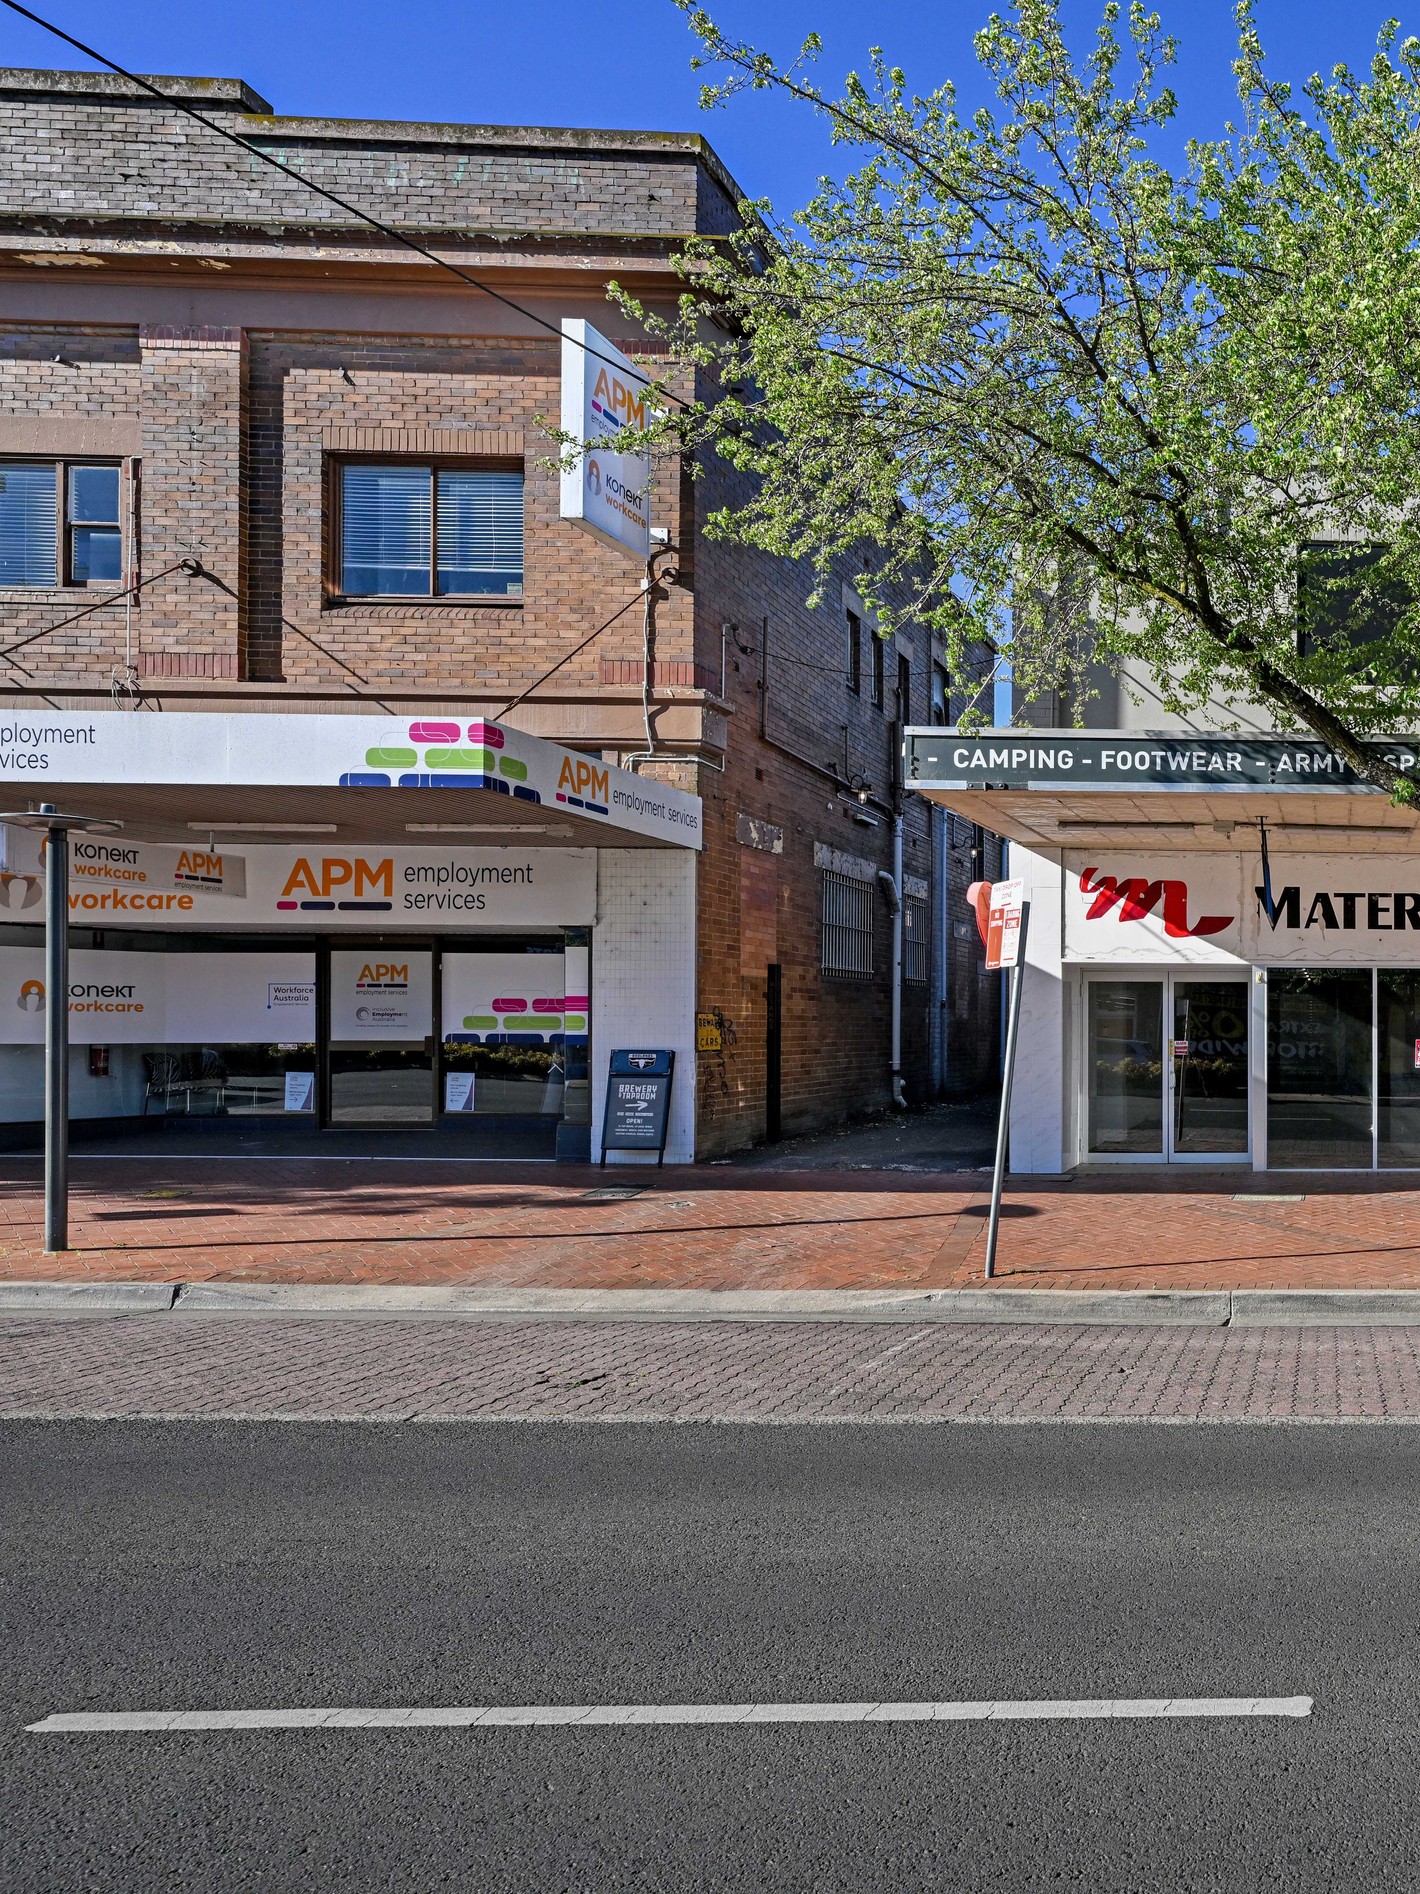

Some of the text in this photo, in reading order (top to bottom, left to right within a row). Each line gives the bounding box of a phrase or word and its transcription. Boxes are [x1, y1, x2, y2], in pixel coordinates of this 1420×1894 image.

[593, 367, 645, 431] APM
[605, 493, 647, 529] workcare
[953, 748, 1074, 770] CAMPING
[1100, 750, 1243, 772] FOOTWEAR
[1276, 753, 1347, 773] ARMY
[558, 755, 698, 829] APM employment services
[74, 863, 147, 882] workcare
[176, 851, 223, 876] APM
[280, 857, 394, 897] APM
[404, 862, 534, 887] employment
[174, 881, 223, 892] employment services
[403, 889, 486, 910] services
[358, 964, 409, 982] APM
[273, 986, 314, 994] Workforce
[273, 994, 309, 1002] Australia
[700, 1037, 719, 1048] CARS
[618, 1084, 658, 1093] BREWERY
[622, 1092, 656, 1100] TAPROOM
